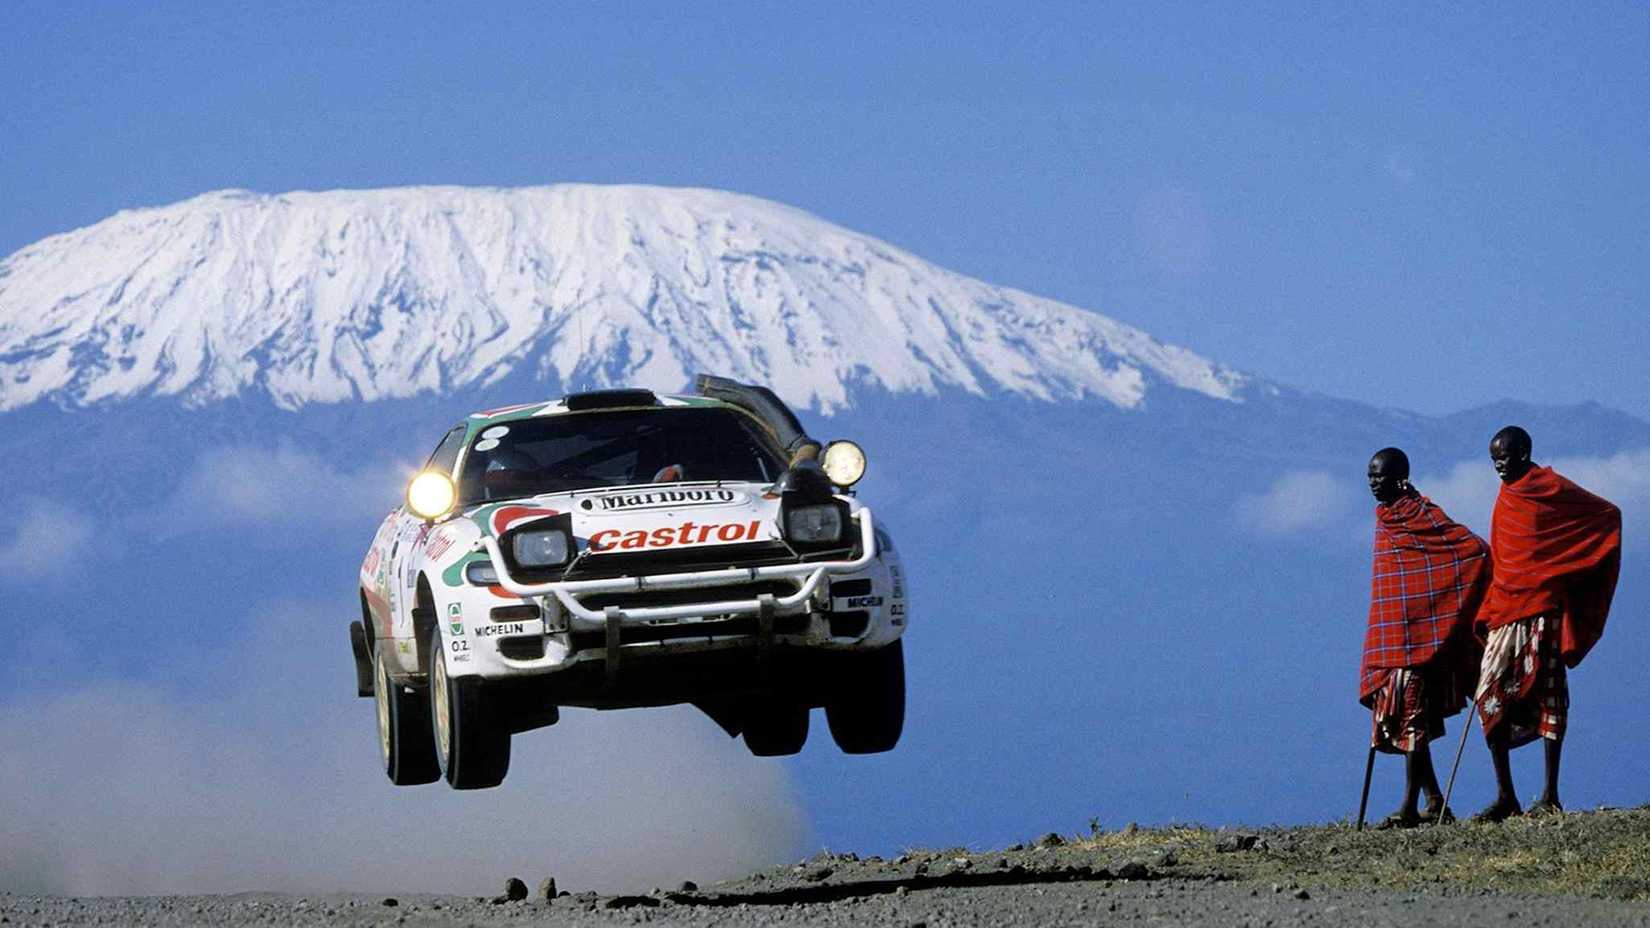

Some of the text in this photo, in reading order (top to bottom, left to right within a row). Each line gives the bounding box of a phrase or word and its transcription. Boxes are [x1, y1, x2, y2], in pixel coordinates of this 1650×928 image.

[602, 490, 734, 510] Marlboro
[588, 520, 761, 552] Castrol
[474, 624, 523, 637] MICHELIN
